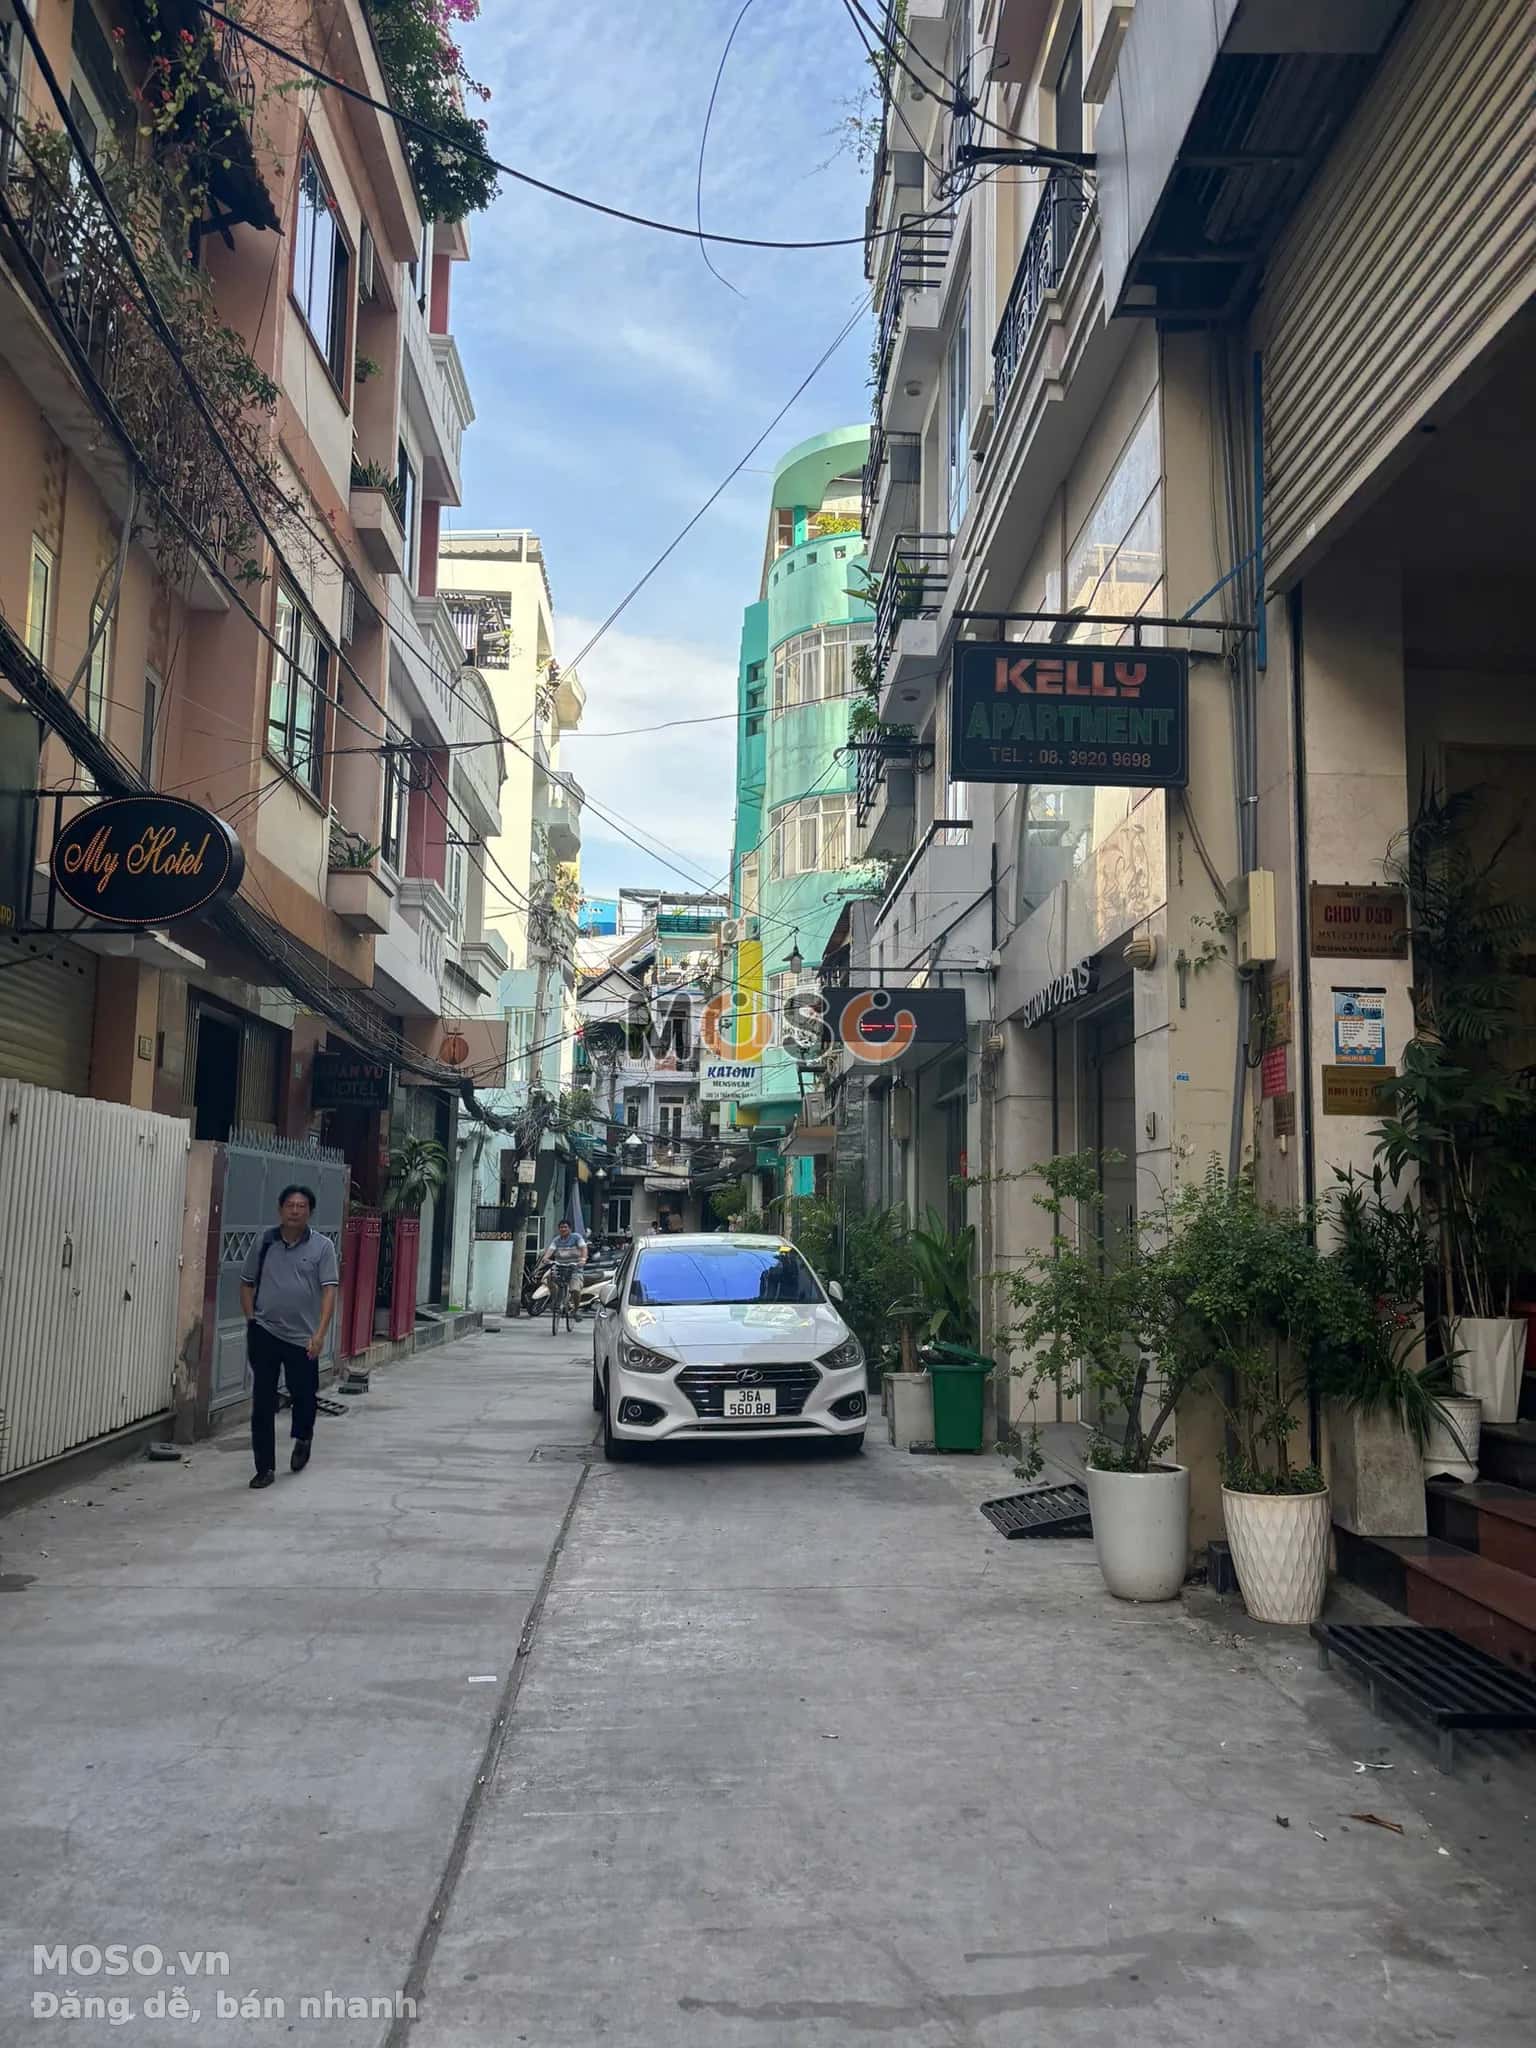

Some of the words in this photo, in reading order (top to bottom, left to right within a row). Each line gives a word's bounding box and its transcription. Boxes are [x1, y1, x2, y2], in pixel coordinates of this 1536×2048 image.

[994, 657, 1148, 699] KELLY
[966, 701, 1176, 746] APARTMENT
[1112, 752, 1153, 768] 9698
[64, 825, 121, 894] My
[126, 825, 211, 875] Hotel
[707, 1066, 756, 1078] KATONI
[738, 1391, 761, 1402] 36A
[729, 1403, 771, 1416] 560.88
